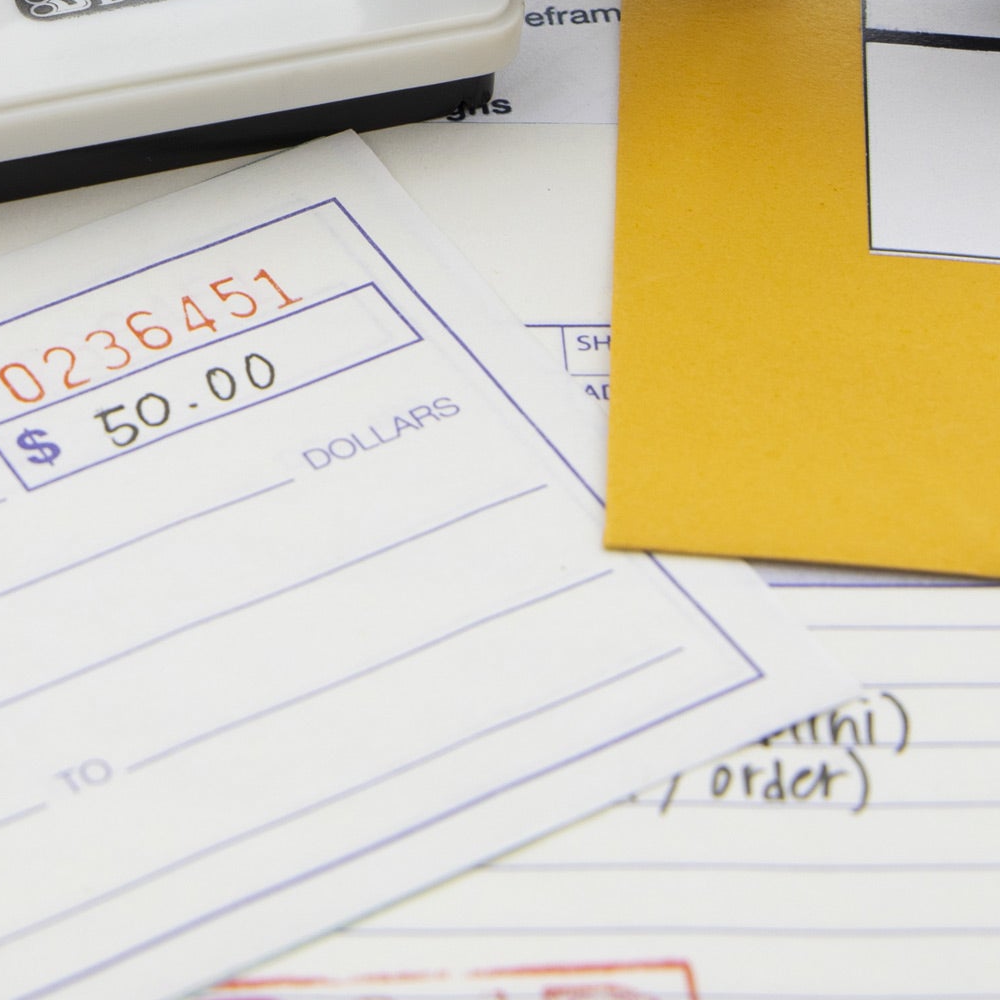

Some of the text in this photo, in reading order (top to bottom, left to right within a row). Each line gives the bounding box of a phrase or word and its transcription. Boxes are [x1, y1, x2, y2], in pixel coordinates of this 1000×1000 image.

[15, 427, 63, 468] $
[302, 395, 462, 472] DOLLARS
[54, 756, 114, 796] TO
[711, 745, 869, 815] order)
